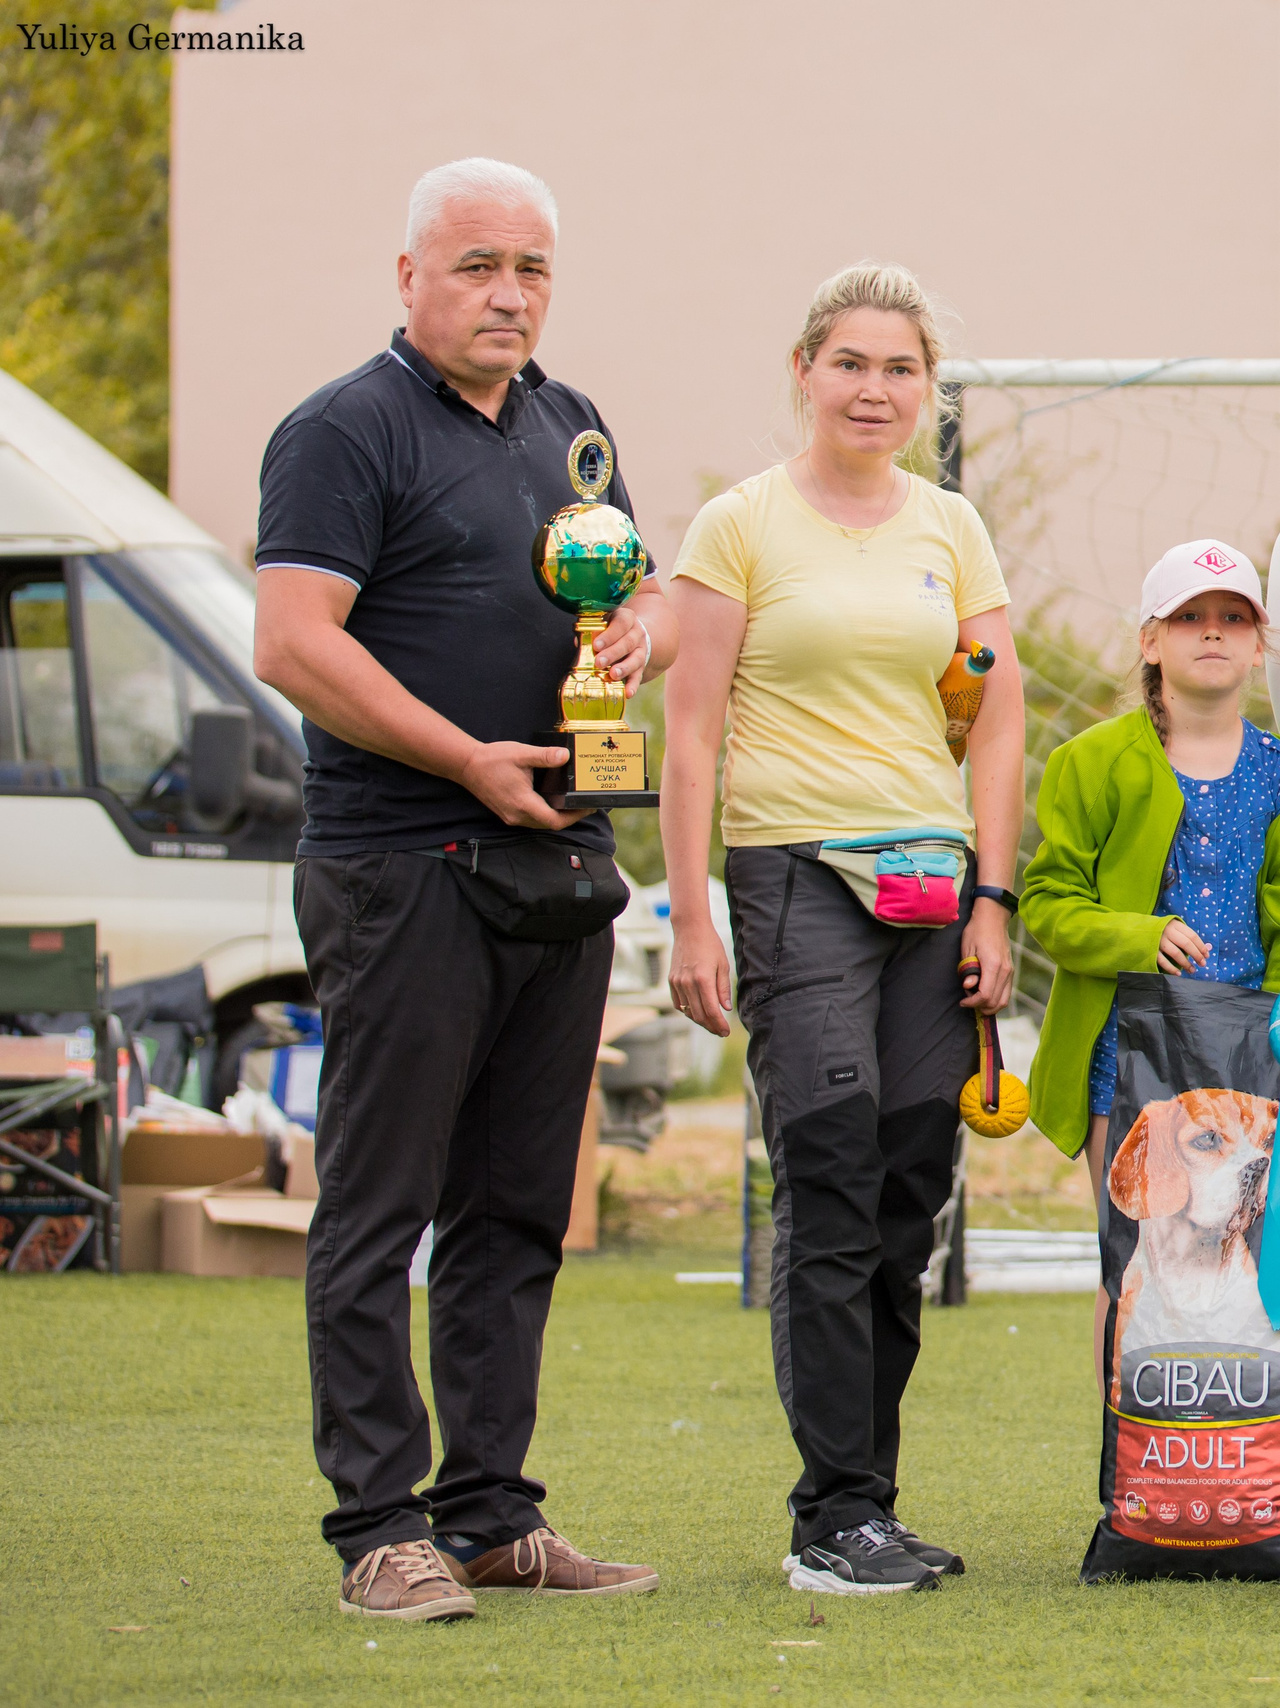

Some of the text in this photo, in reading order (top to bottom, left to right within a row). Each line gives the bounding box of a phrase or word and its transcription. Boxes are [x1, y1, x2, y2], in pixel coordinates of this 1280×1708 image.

[589, 765, 627, 773] ЛУЧШАЯ
[596, 774, 621, 782] СУКА
[1132, 1360, 1270, 1408] CIBAU
[1140, 1436, 1255, 1469] ADULT
[1252, 1478, 1273, 1486] DOGS
[1154, 1536, 1240, 1547] MAINTENANCE FORMULA
